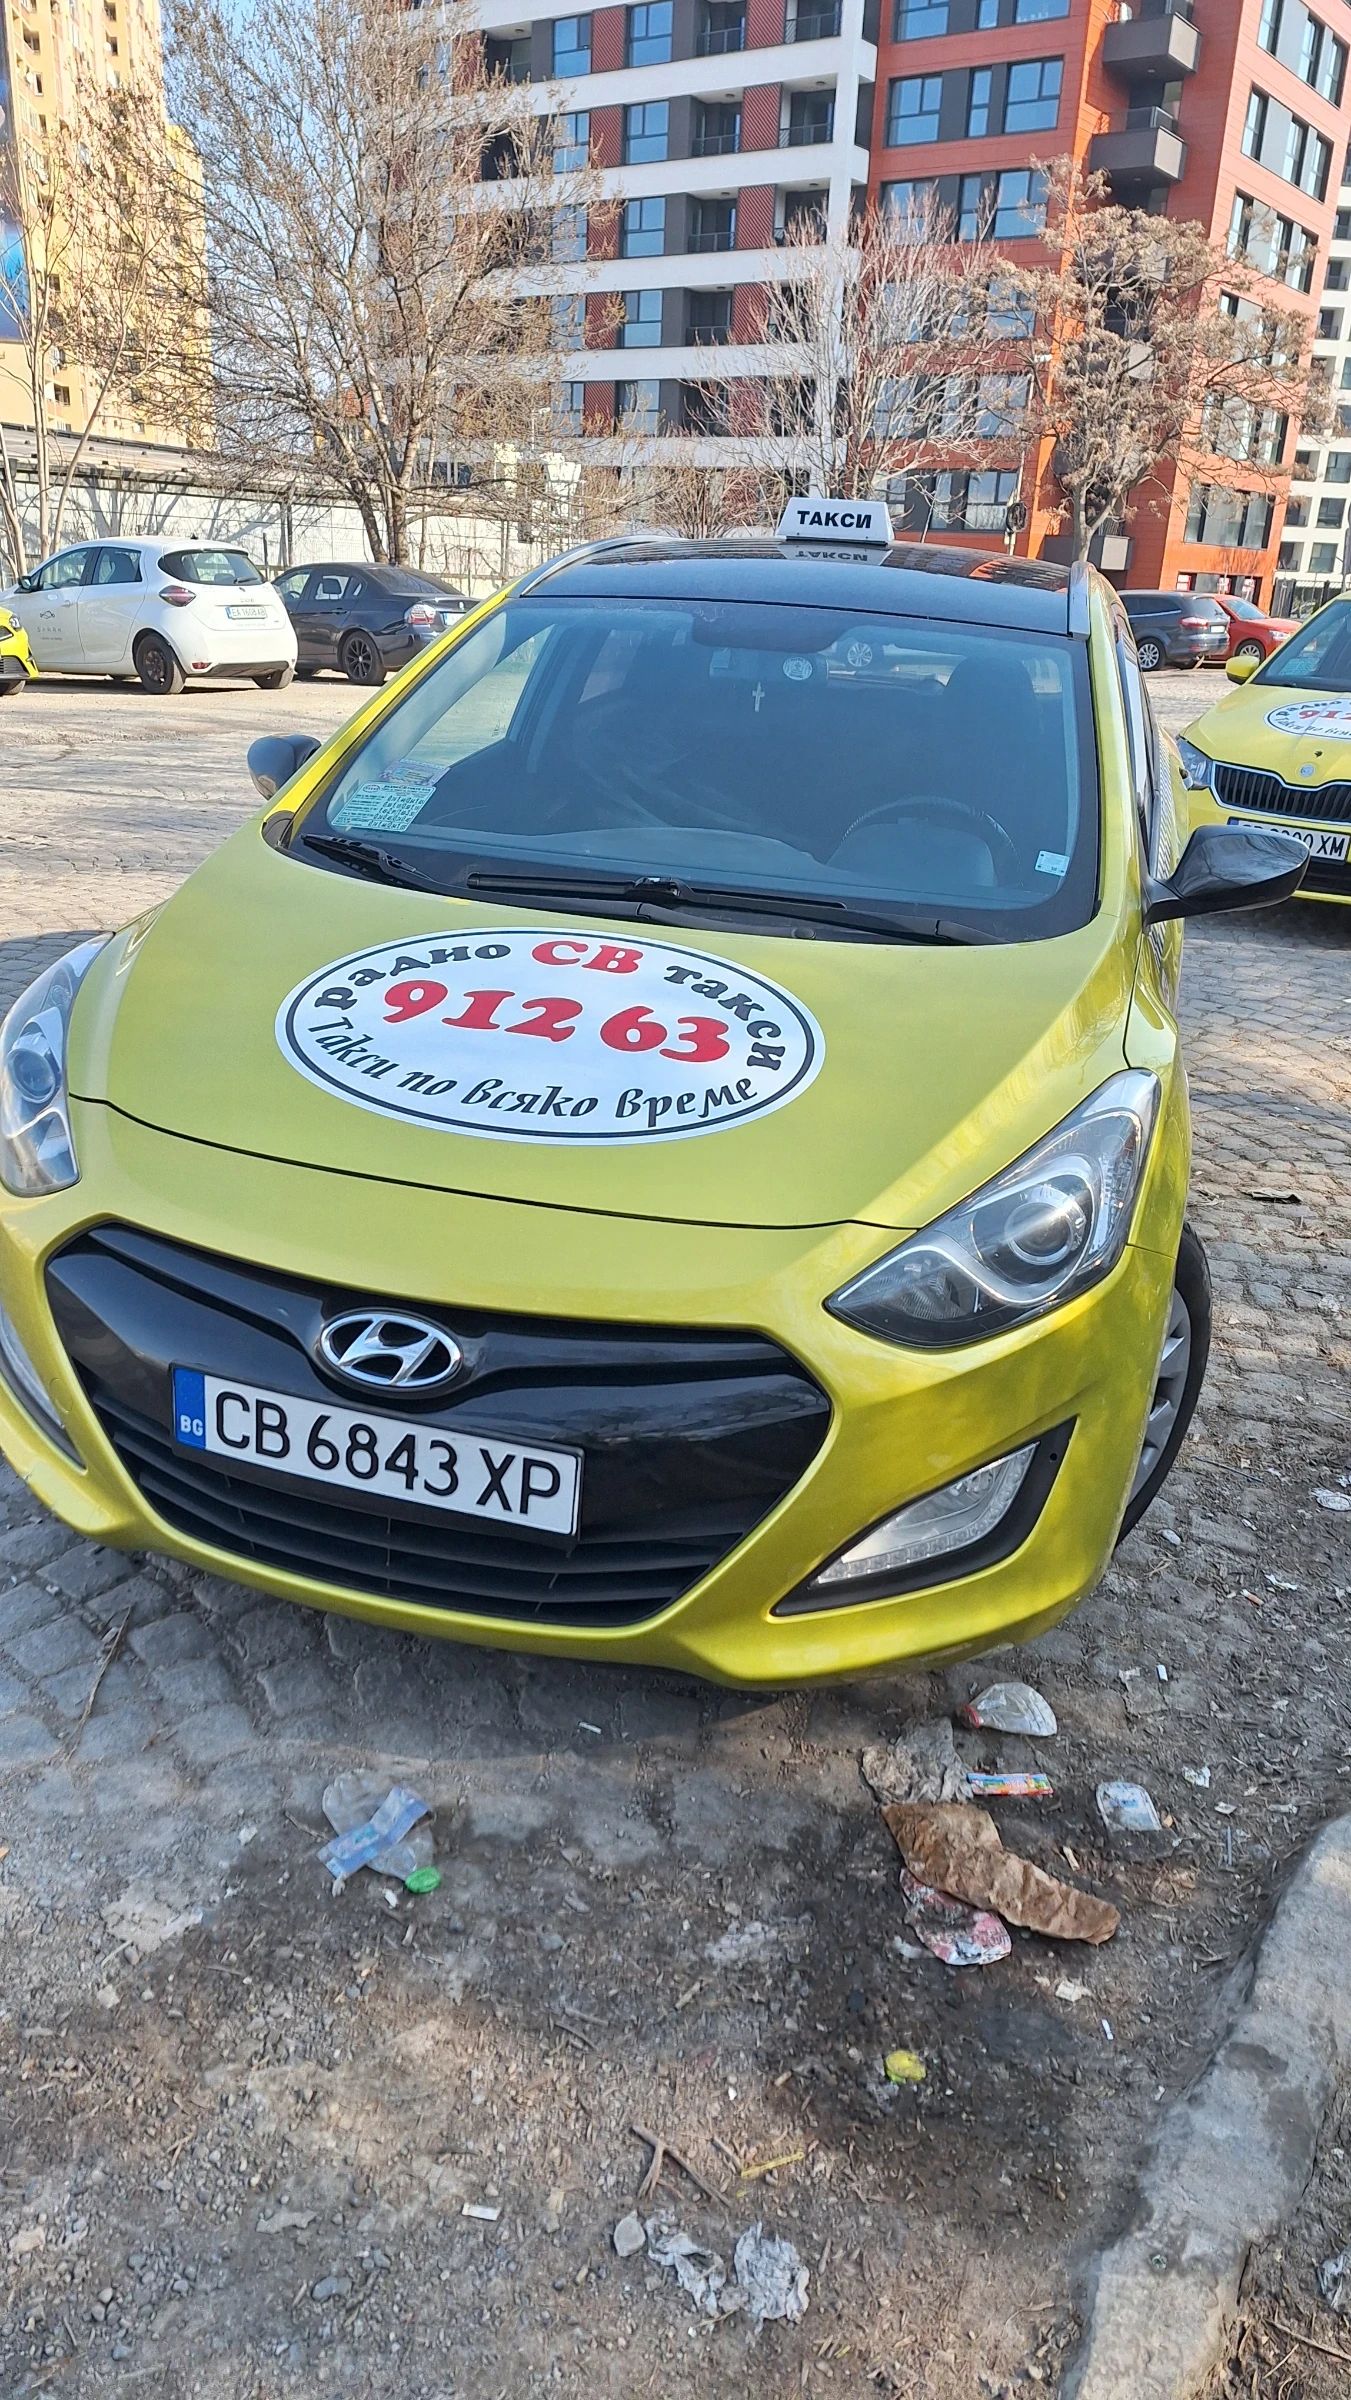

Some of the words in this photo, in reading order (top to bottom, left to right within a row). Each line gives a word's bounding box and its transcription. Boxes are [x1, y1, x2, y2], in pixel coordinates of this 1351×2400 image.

[797, 510, 872, 529] ТАКСИ
[314, 944, 511, 1011] радио
[664, 965, 786, 1071] такси
[383, 979, 584, 1043] 912
[600, 1005, 731, 1063] 63
[308, 1016, 400, 1080] Такси
[396, 1071, 458, 1096] по
[460, 1078, 599, 1118] всяко
[614, 1077, 758, 1128] време
[180, 1414, 204, 1437] BG
[306, 1414, 459, 1497] 6843
